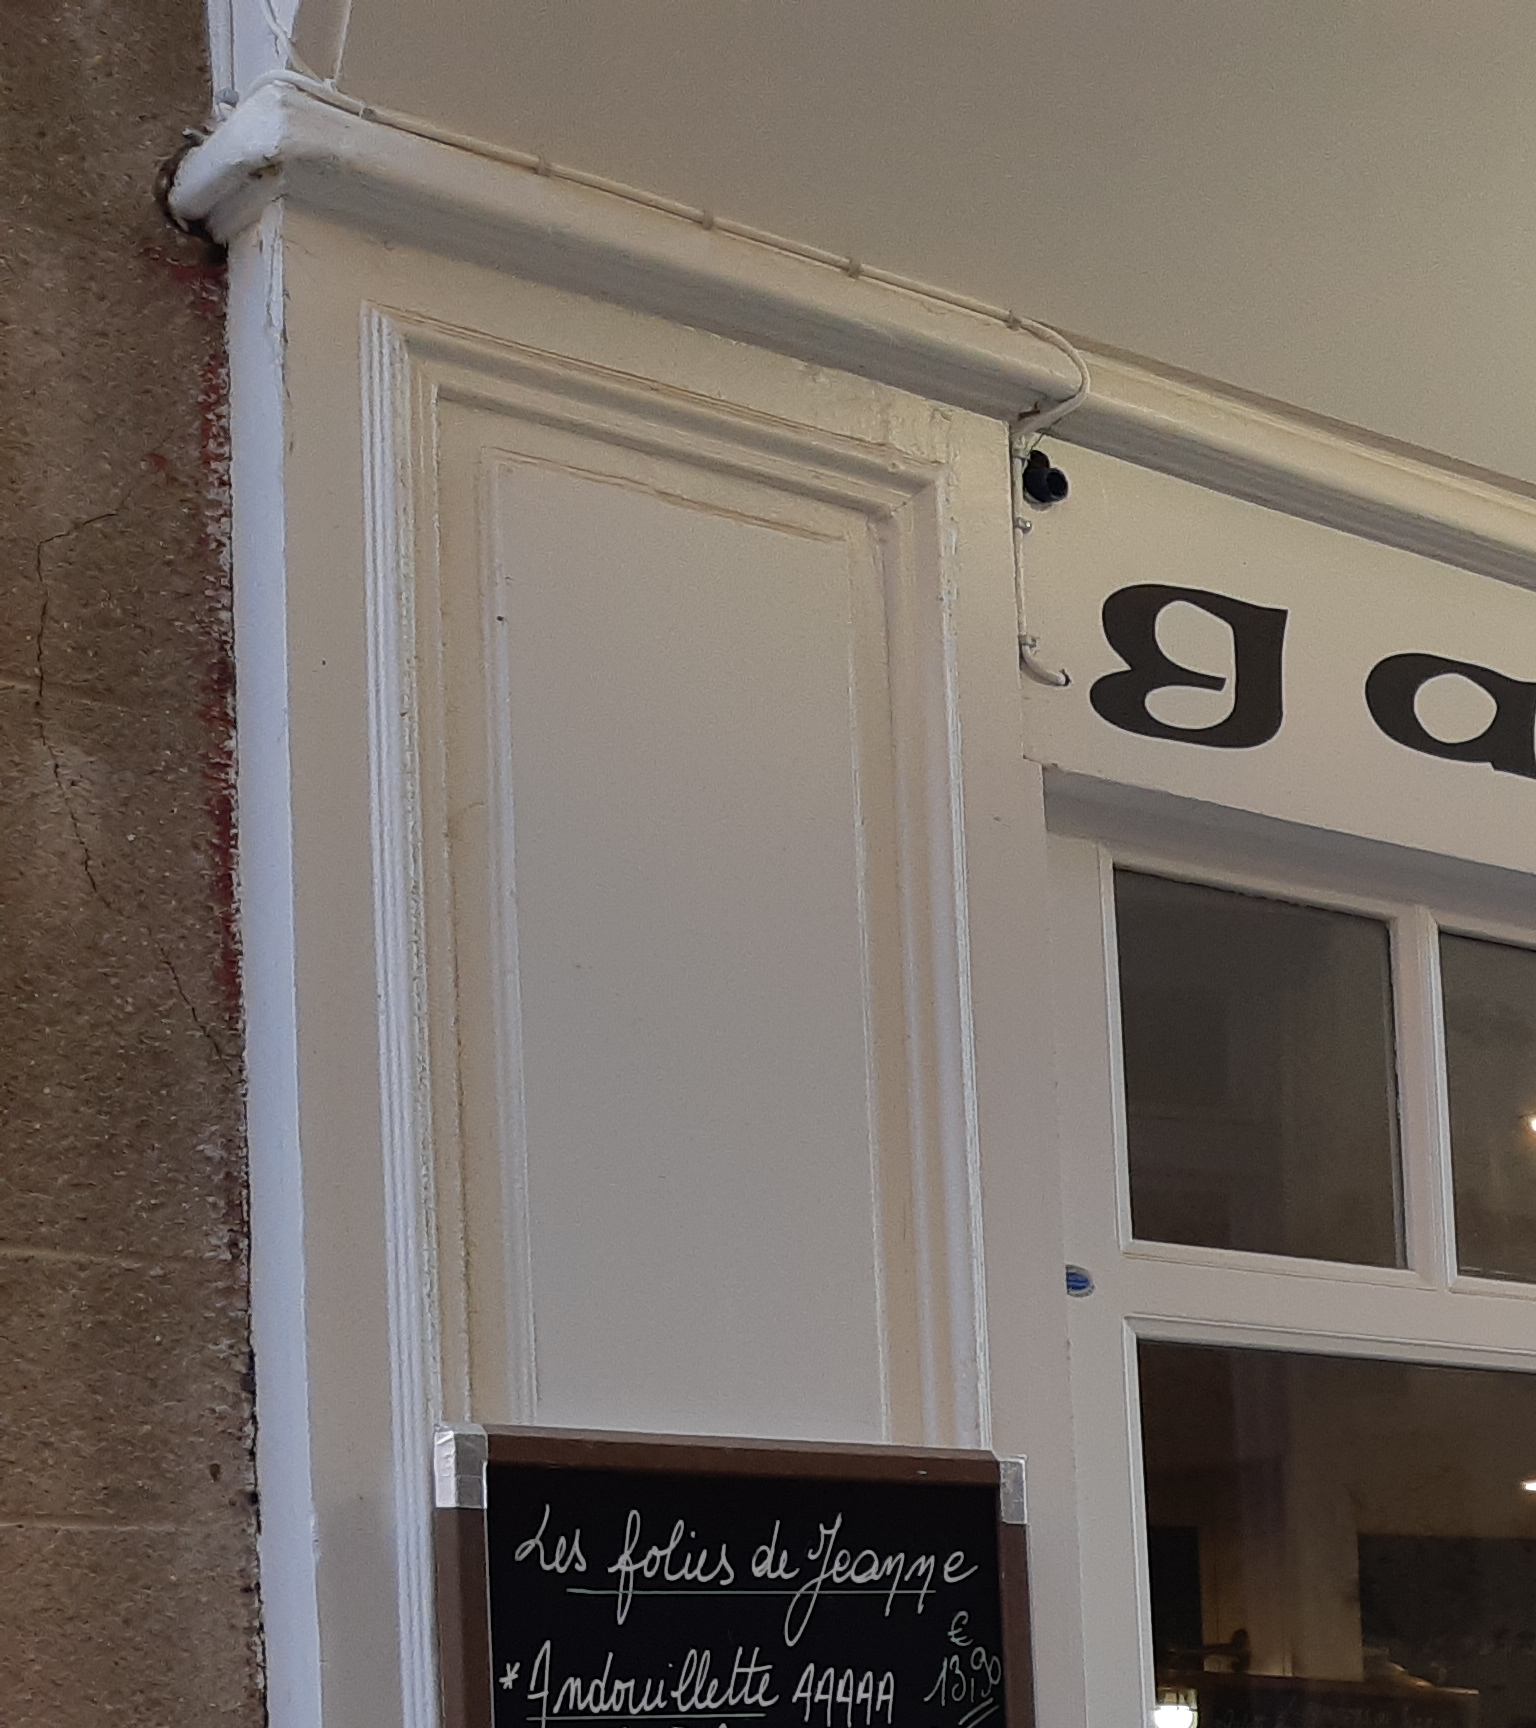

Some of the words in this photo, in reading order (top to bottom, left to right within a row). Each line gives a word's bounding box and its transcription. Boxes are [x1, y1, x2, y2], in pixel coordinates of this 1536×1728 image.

[513, 1503, 587, 1576] Les
[606, 1509, 736, 1625] folies
[751, 1518, 801, 1584] de
[783, 1513, 979, 1647] Jeanne
